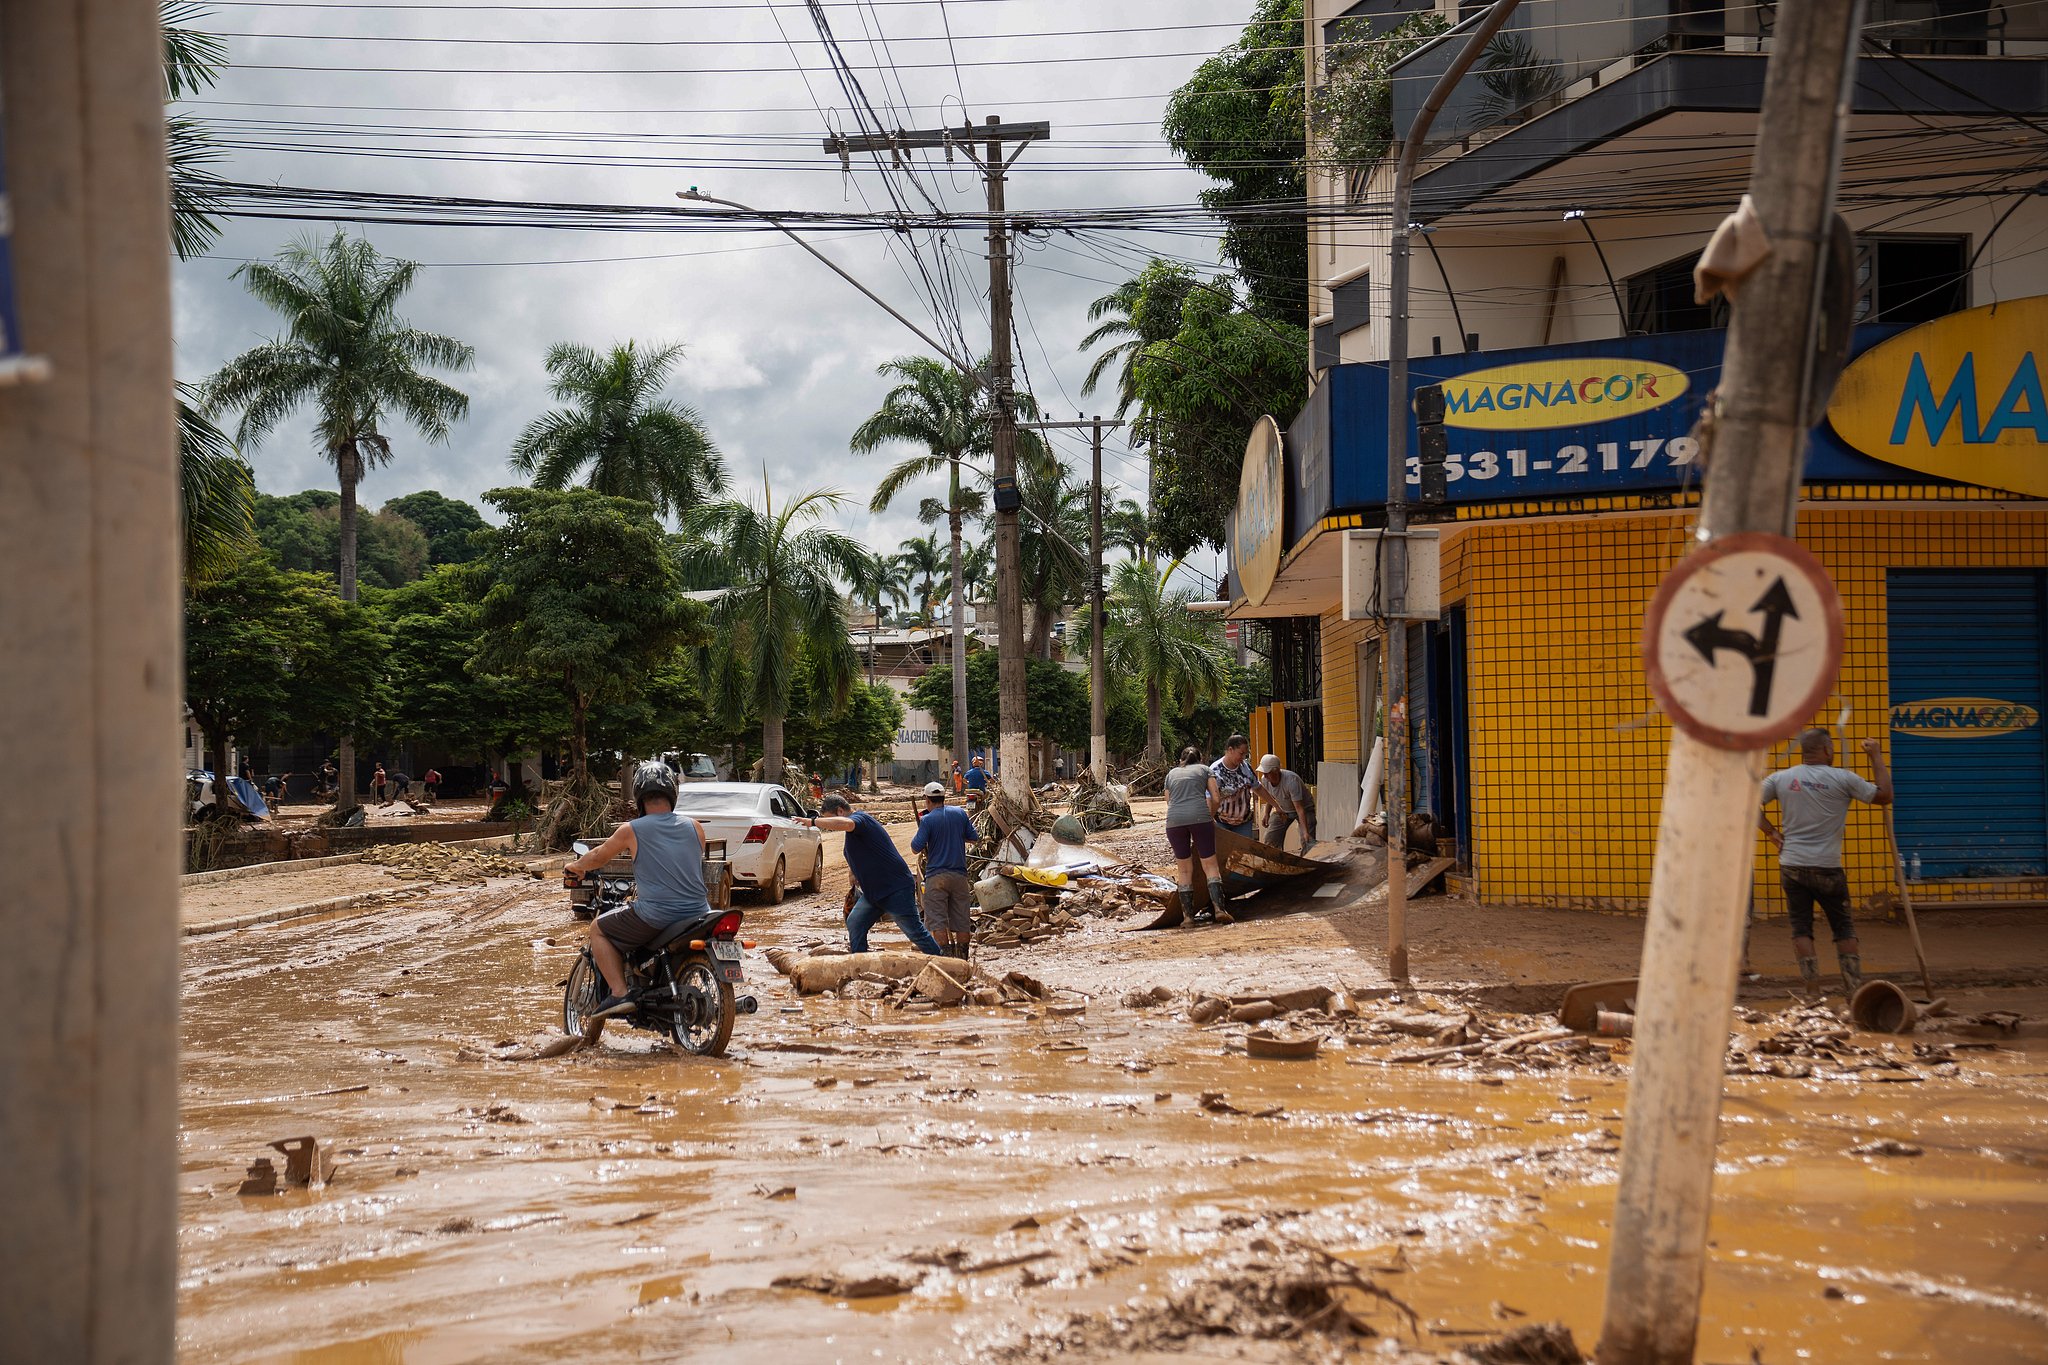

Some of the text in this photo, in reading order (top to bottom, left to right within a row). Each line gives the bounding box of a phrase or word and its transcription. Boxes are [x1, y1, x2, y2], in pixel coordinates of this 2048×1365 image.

[1444, 373, 1660, 415] MAGNACOR
[1889, 351, 2048, 447] MA
[1890, 707, 2030, 728] MAGNACOR
